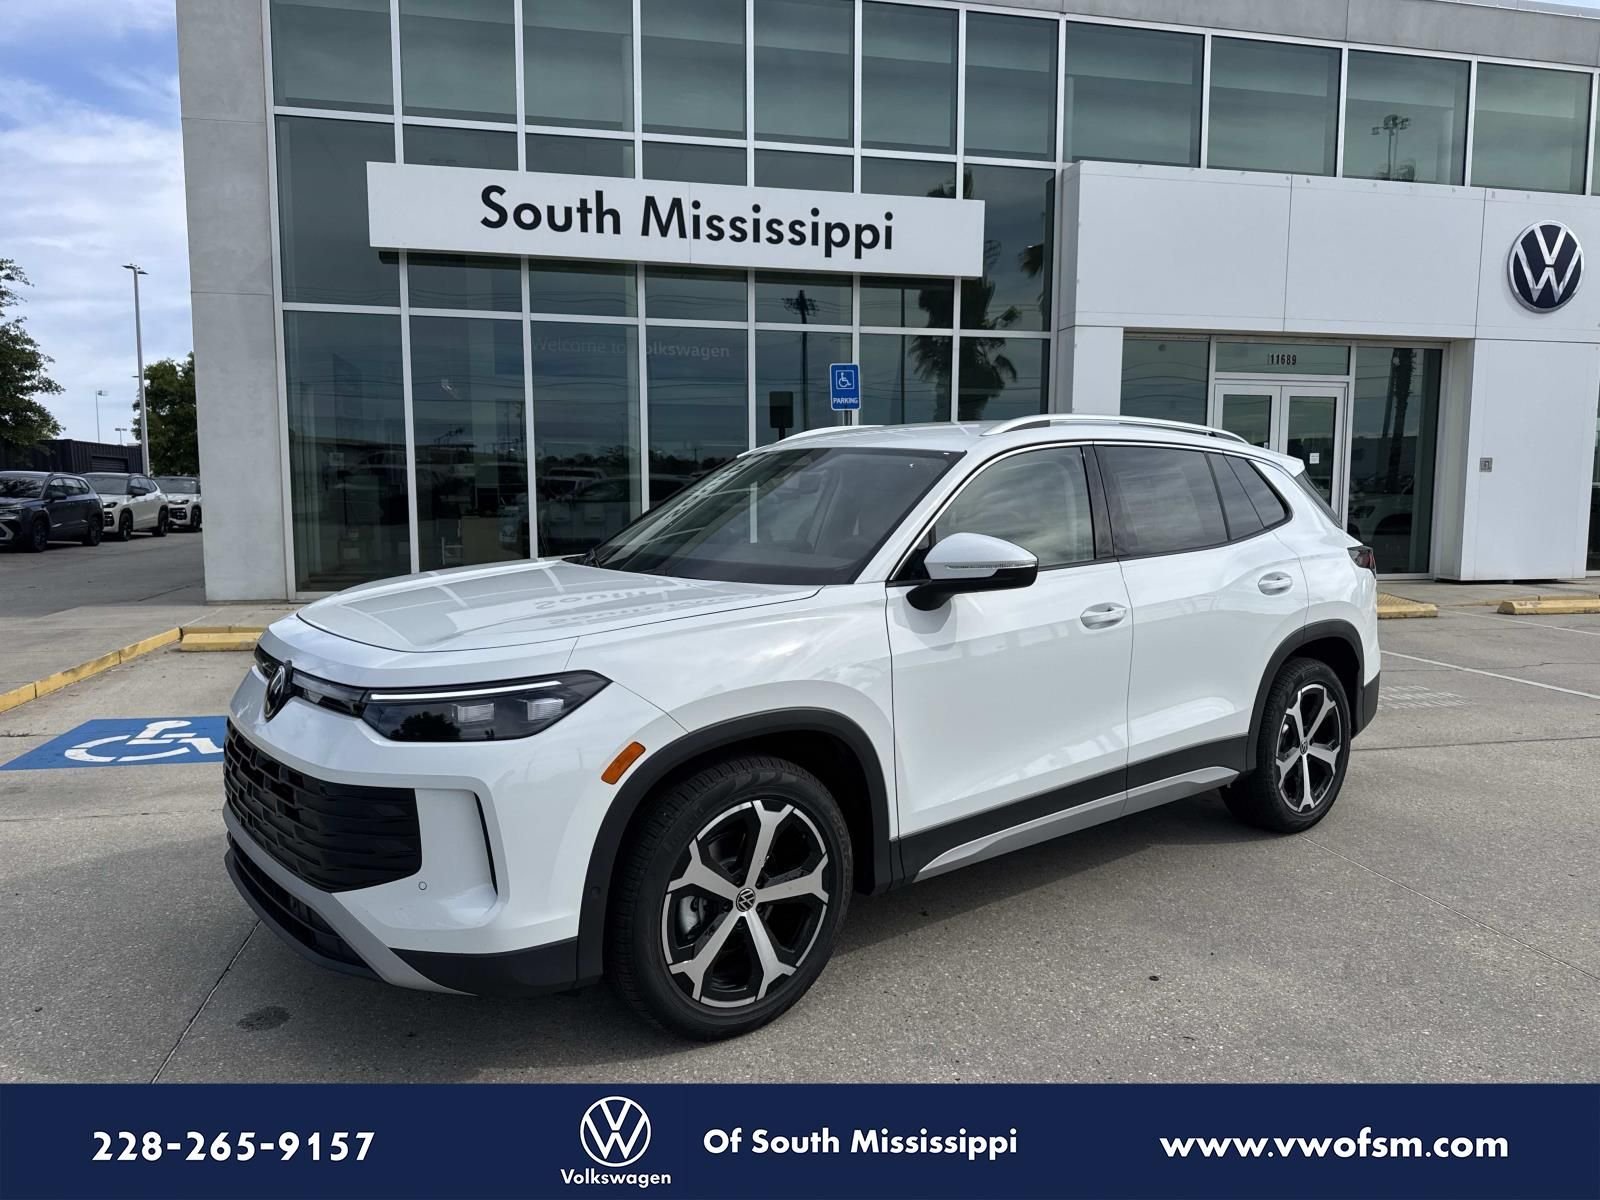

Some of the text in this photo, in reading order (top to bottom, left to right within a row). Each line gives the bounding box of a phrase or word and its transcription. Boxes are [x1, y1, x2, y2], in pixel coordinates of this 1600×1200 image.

[481, 185, 894, 259] South Mississippi
[1509, 221, 1583, 308] VW
[532, 336, 730, 361] Welcome to olkswagen
[1270, 353, 1297, 366] 11689
